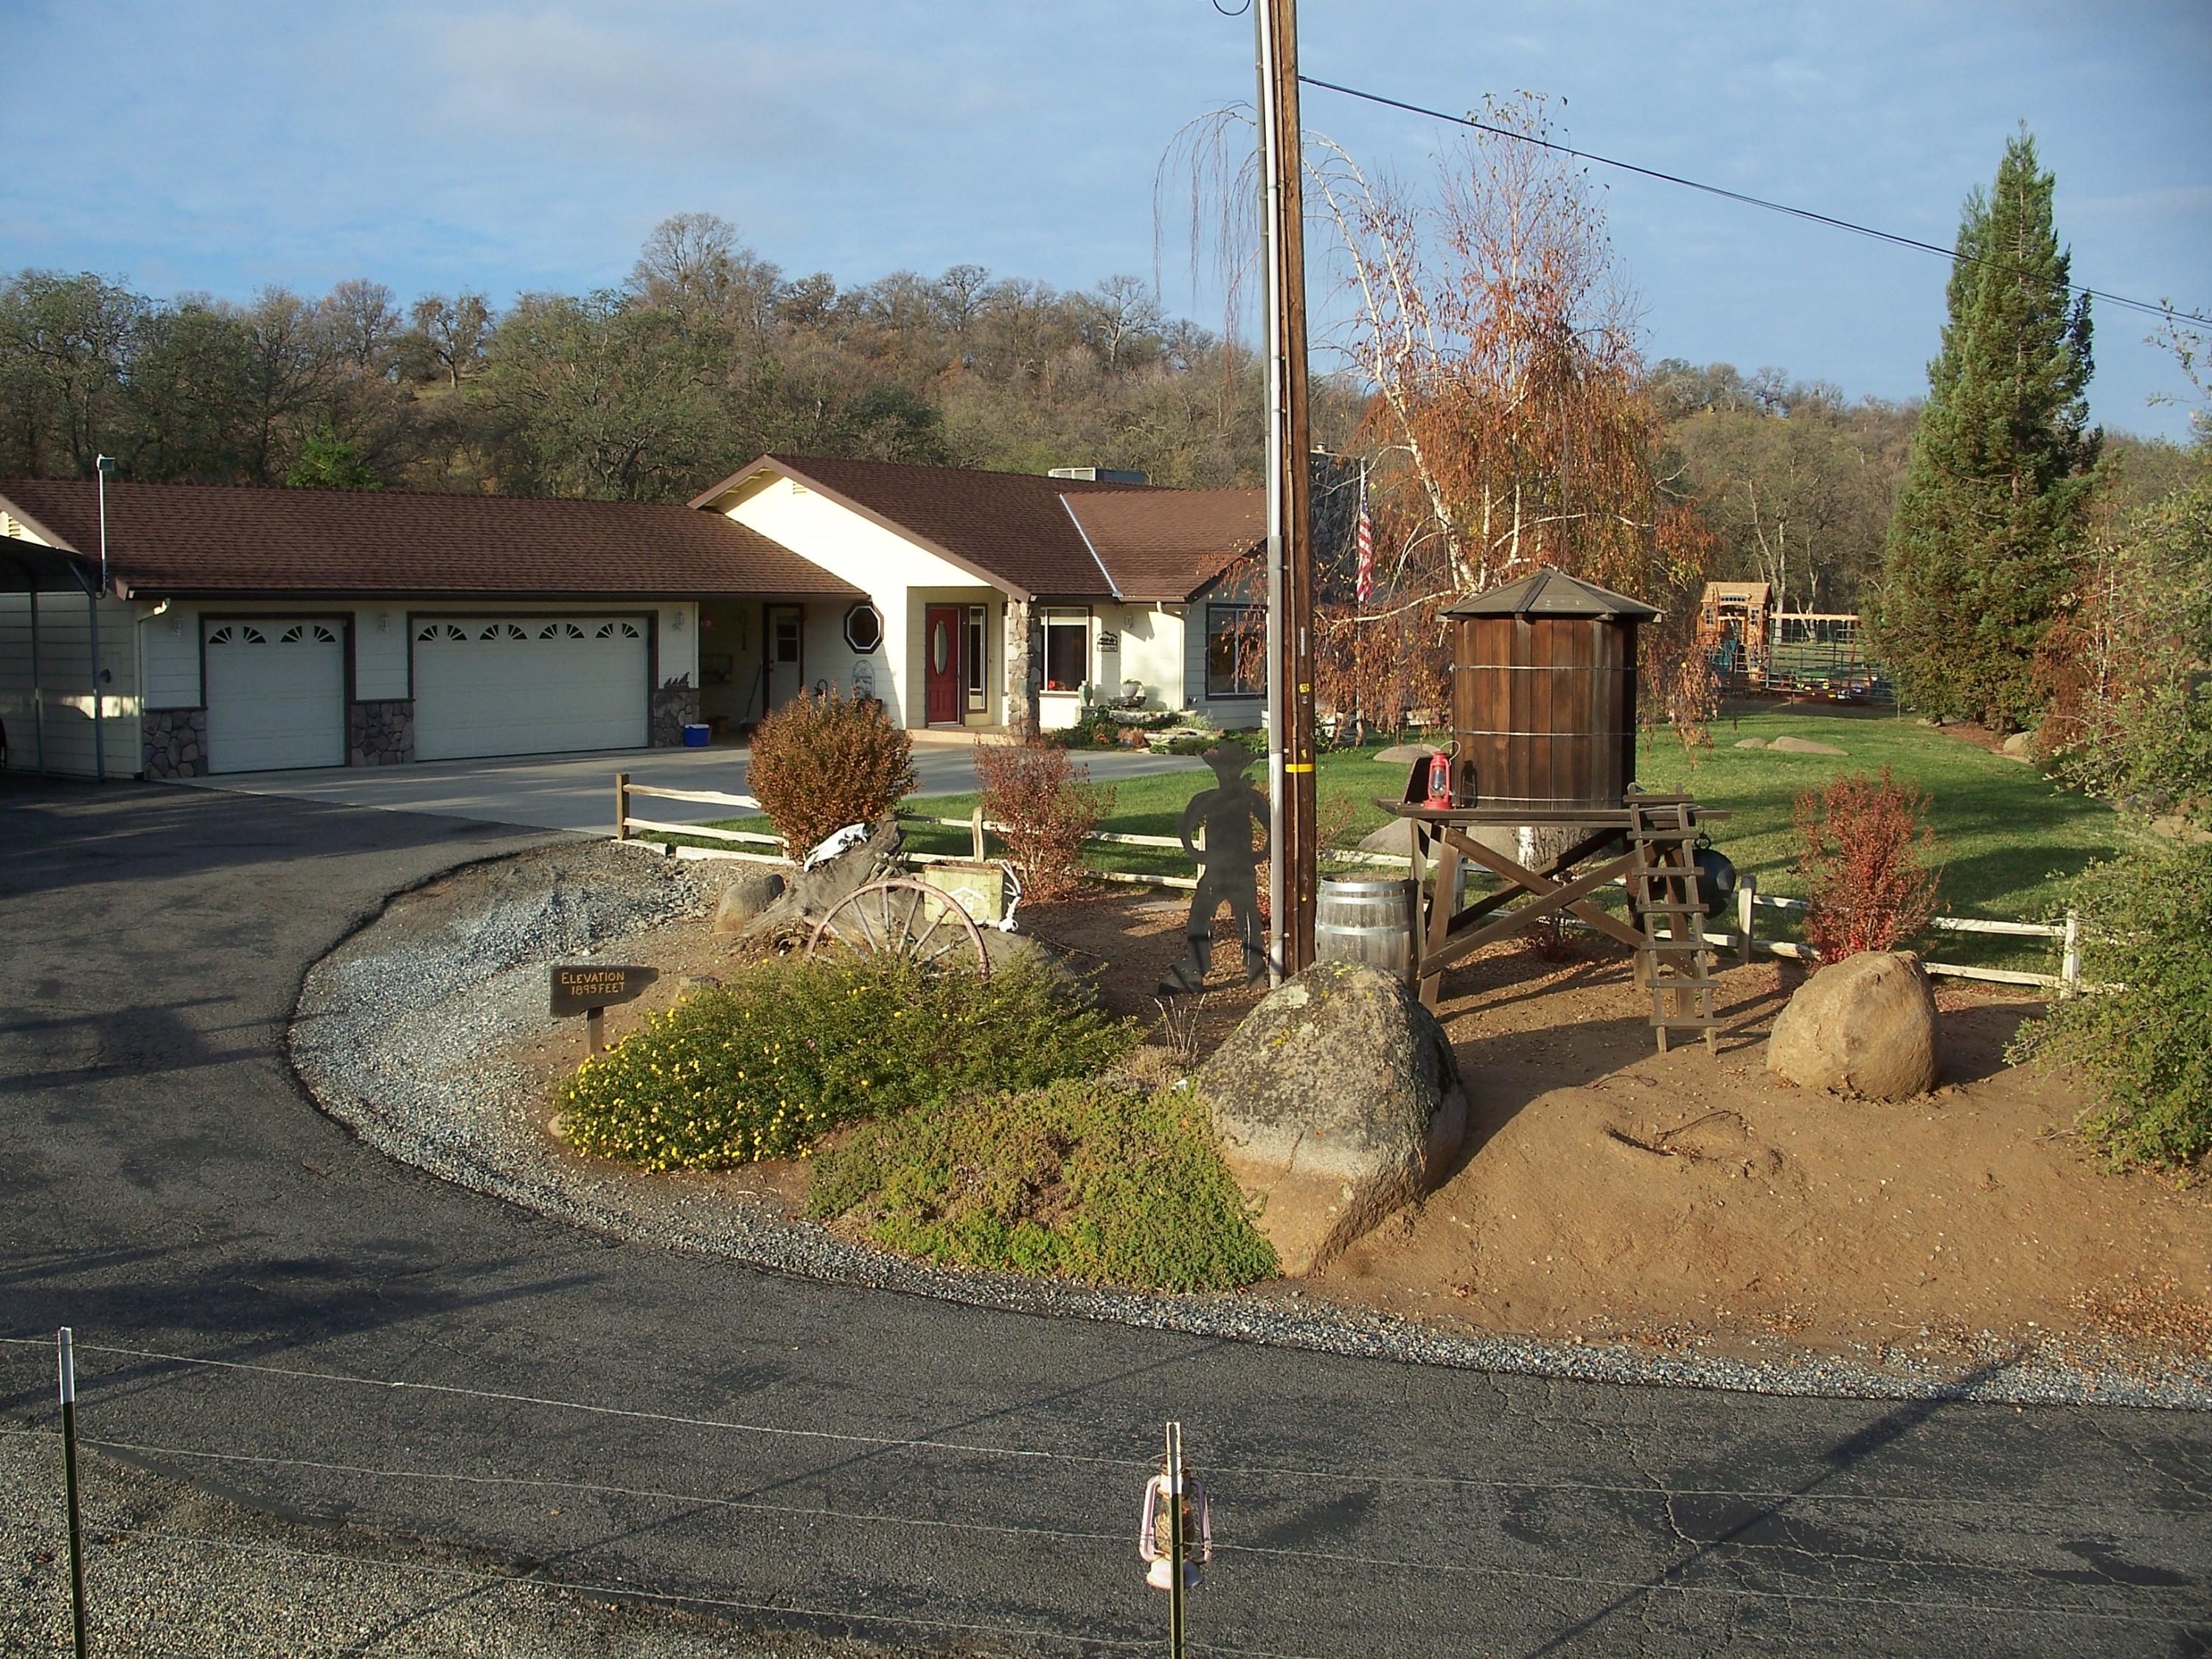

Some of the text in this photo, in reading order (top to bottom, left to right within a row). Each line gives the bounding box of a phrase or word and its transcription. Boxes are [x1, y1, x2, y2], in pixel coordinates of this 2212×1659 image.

[562, 972, 625, 984] ELEVATION
[571, 982, 625, 995] 1895 FEET
